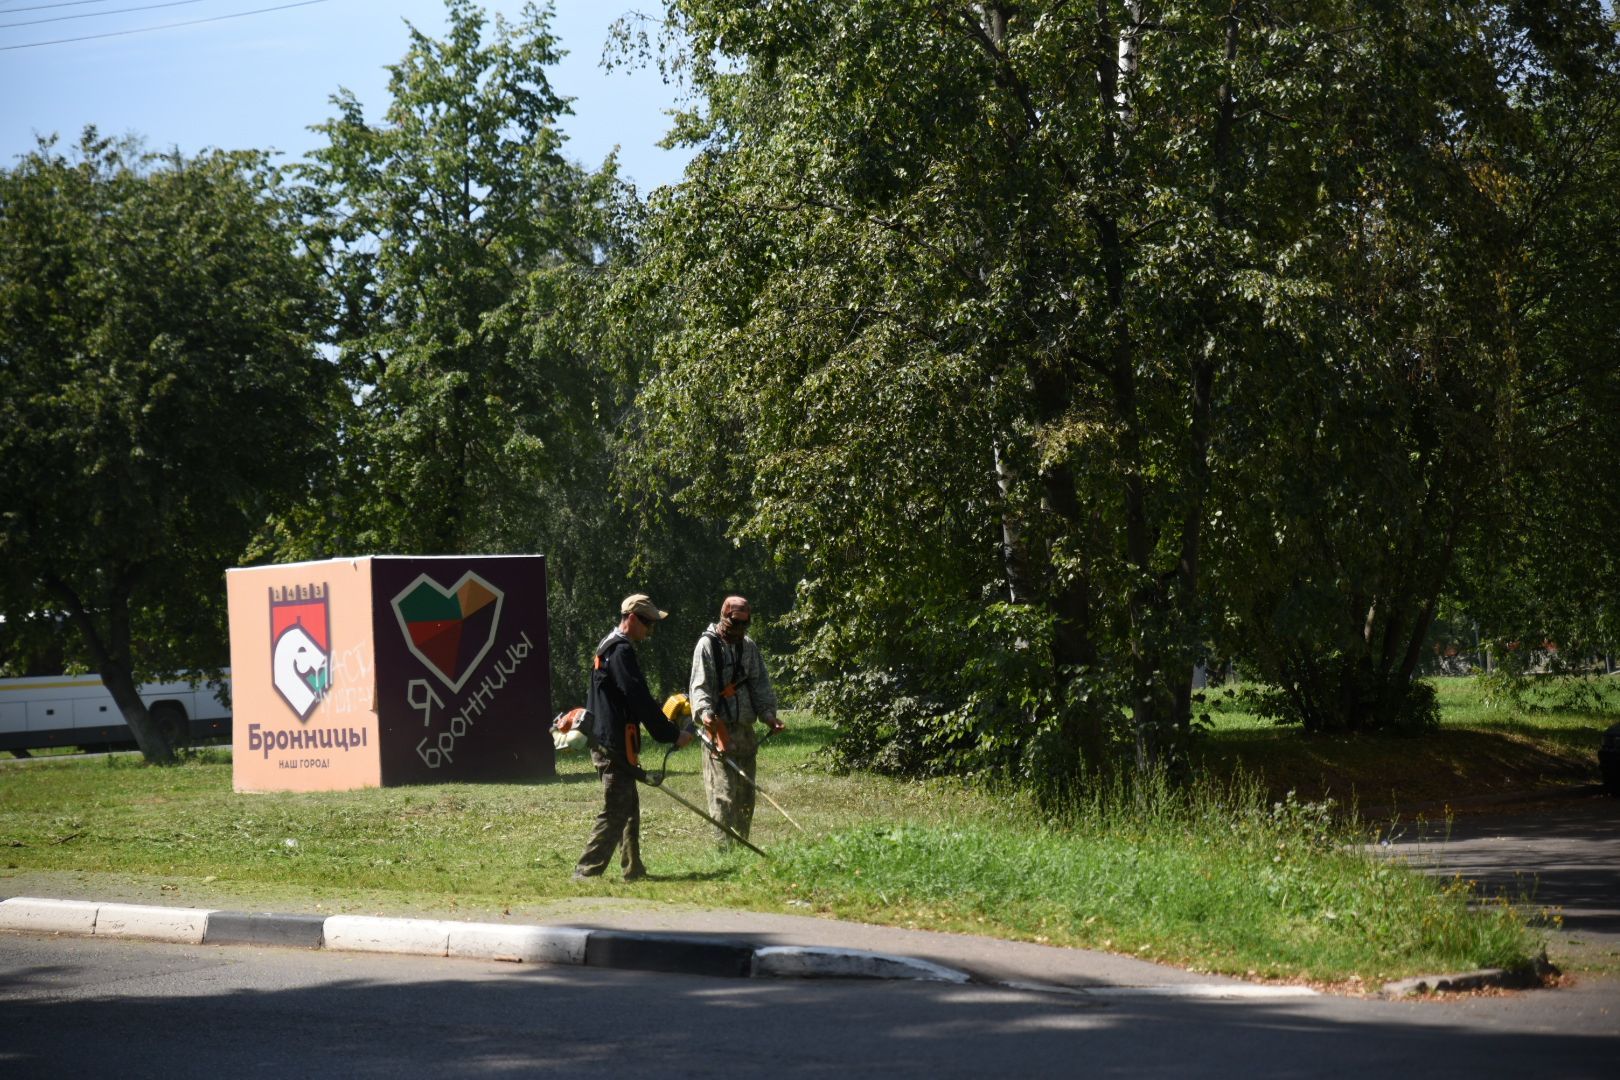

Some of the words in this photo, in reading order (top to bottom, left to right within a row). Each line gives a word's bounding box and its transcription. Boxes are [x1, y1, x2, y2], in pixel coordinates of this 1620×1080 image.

[407, 678, 445, 727] Я
[416, 630, 533, 769] Бронницы
[247, 723, 368, 760] Бронницы
[278, 759, 298, 769] НАШ
[300, 758, 331, 769] ГОРОД!
